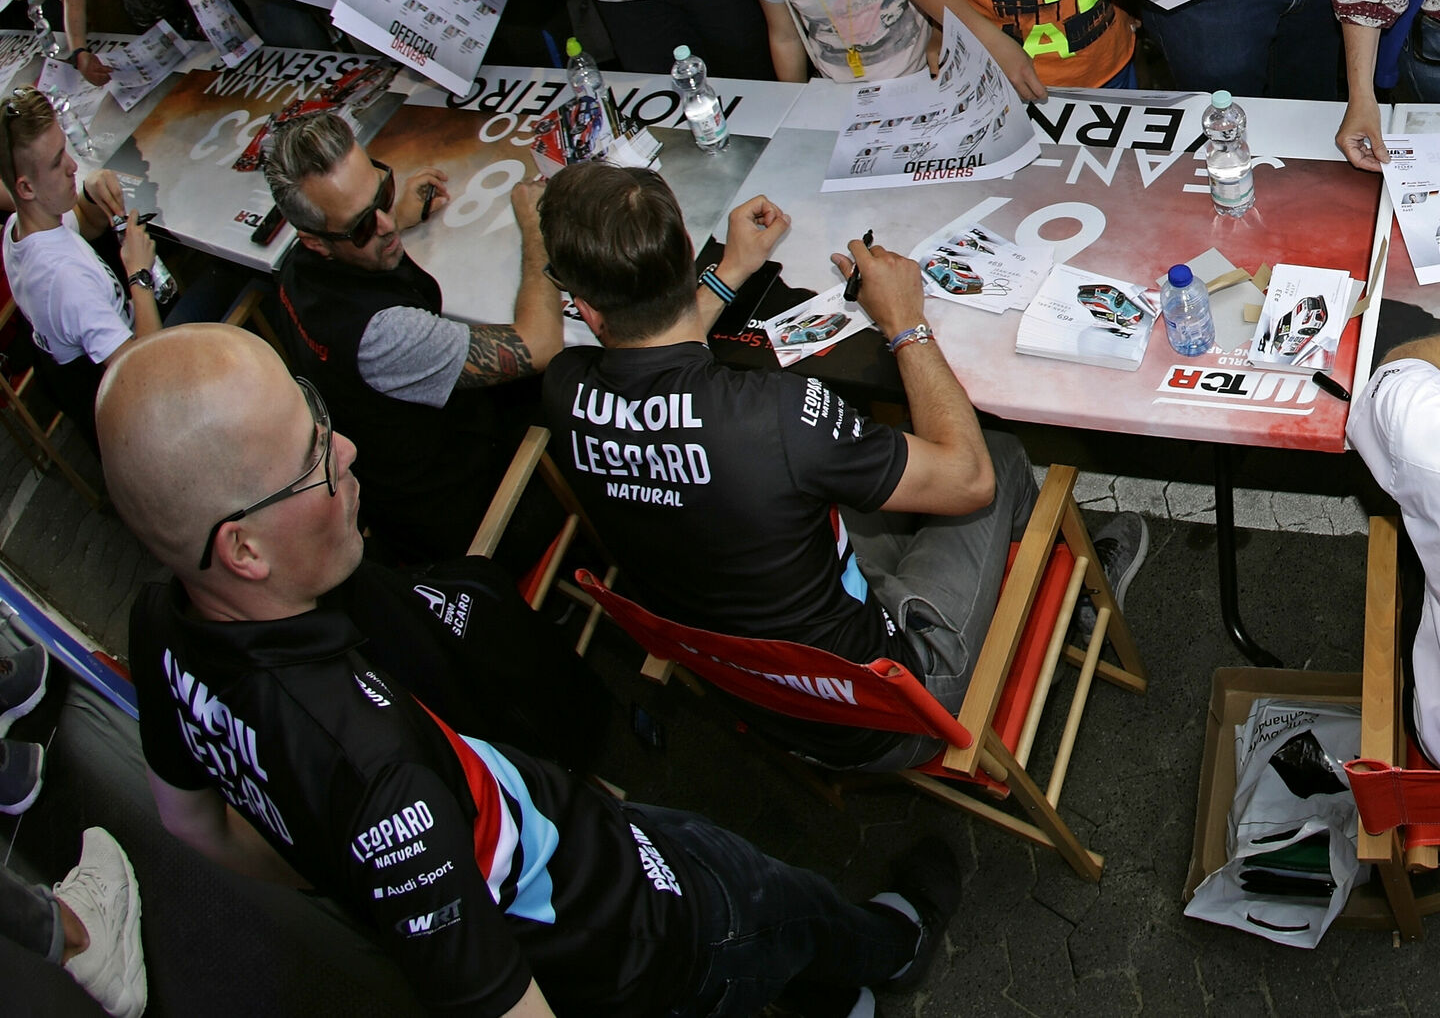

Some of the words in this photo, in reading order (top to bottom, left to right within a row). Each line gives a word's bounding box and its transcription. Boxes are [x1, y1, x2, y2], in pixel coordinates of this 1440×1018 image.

[390, 19, 439, 61] OFFICIAL
[390, 37, 429, 68] DRIVERS
[204, 71, 321, 105] NJAMIN
[902, 152, 987, 175] OFFICIAL
[912, 167, 975, 182] DRIVERS
[1056, 313, 1075, 323] #69
[571, 382, 703, 432] LUKOIL
[571, 429, 712, 486] LEOPARD
[606, 482, 684, 508] NATURAL
[451, 592, 471, 637] SCARO
[350, 799, 435, 864] LEOPARD
[374, 839, 428, 870] NATURAL
[386, 877, 418, 898] Audi
[416, 859, 455, 887] Sport
[407, 897, 463, 935] WRT
